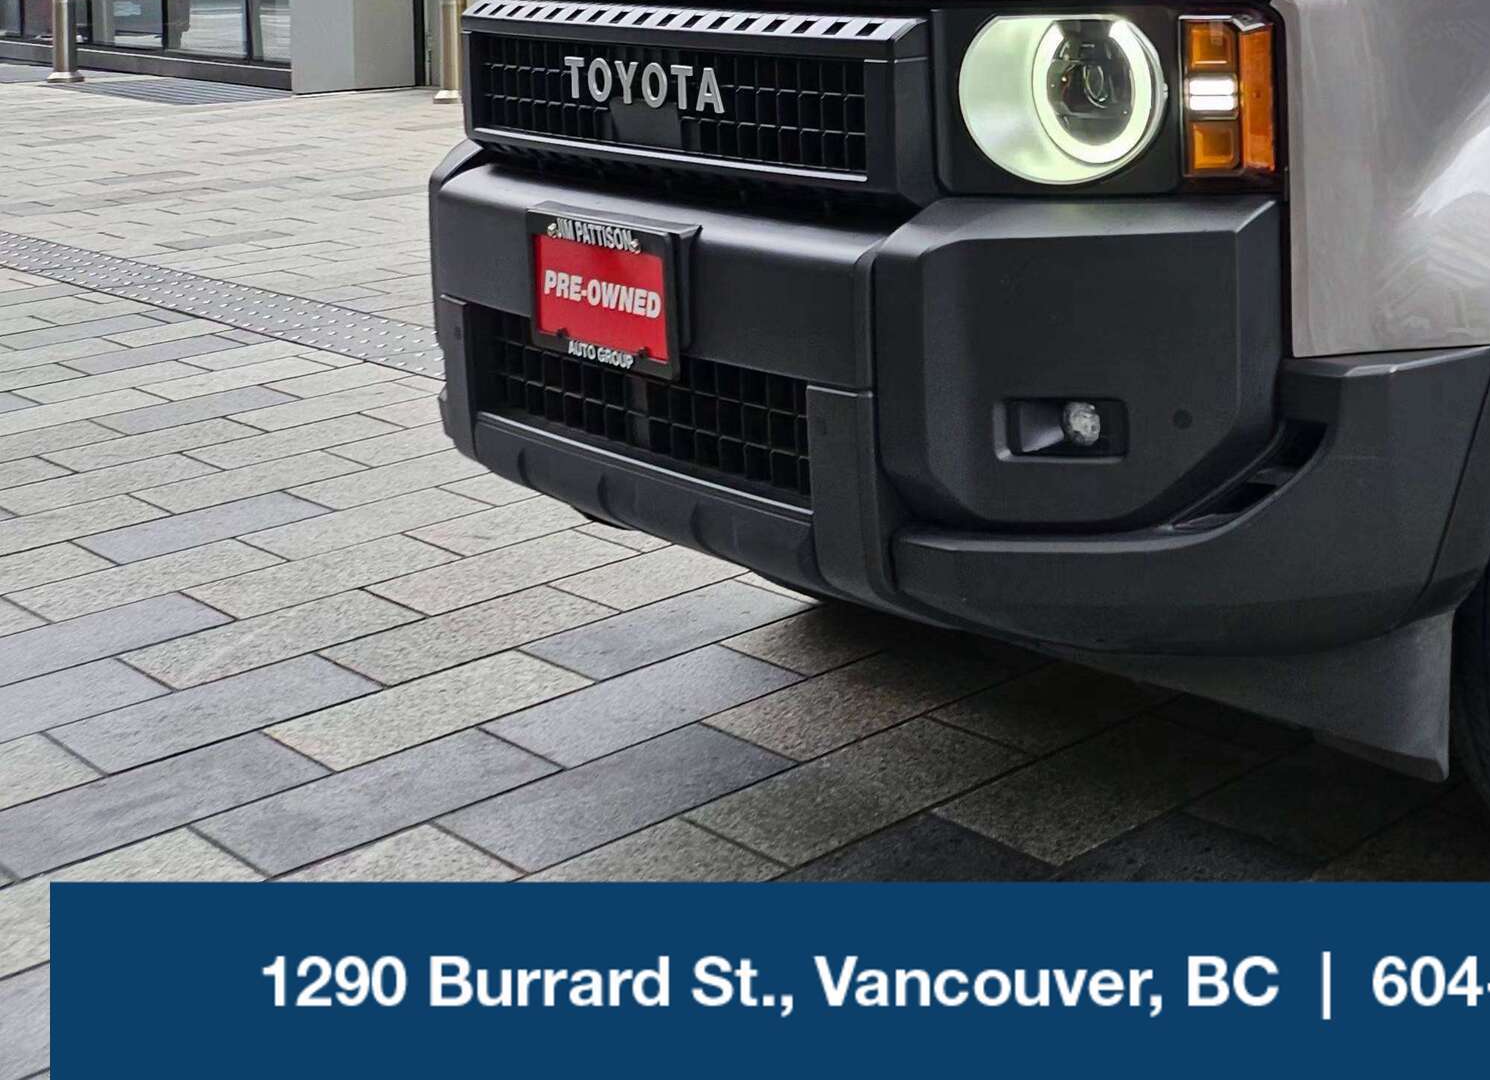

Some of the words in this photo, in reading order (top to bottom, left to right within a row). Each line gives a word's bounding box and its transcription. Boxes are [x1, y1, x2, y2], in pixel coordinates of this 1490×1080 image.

[564, 56, 725, 114] TOYOTA
[556, 217, 573, 240] JIM
[575, 220, 634, 253] PATTISON
[543, 269, 662, 319] PRE-OWNED
[568, 339, 596, 361] AUTO
[597, 346, 635, 370] GROUP
